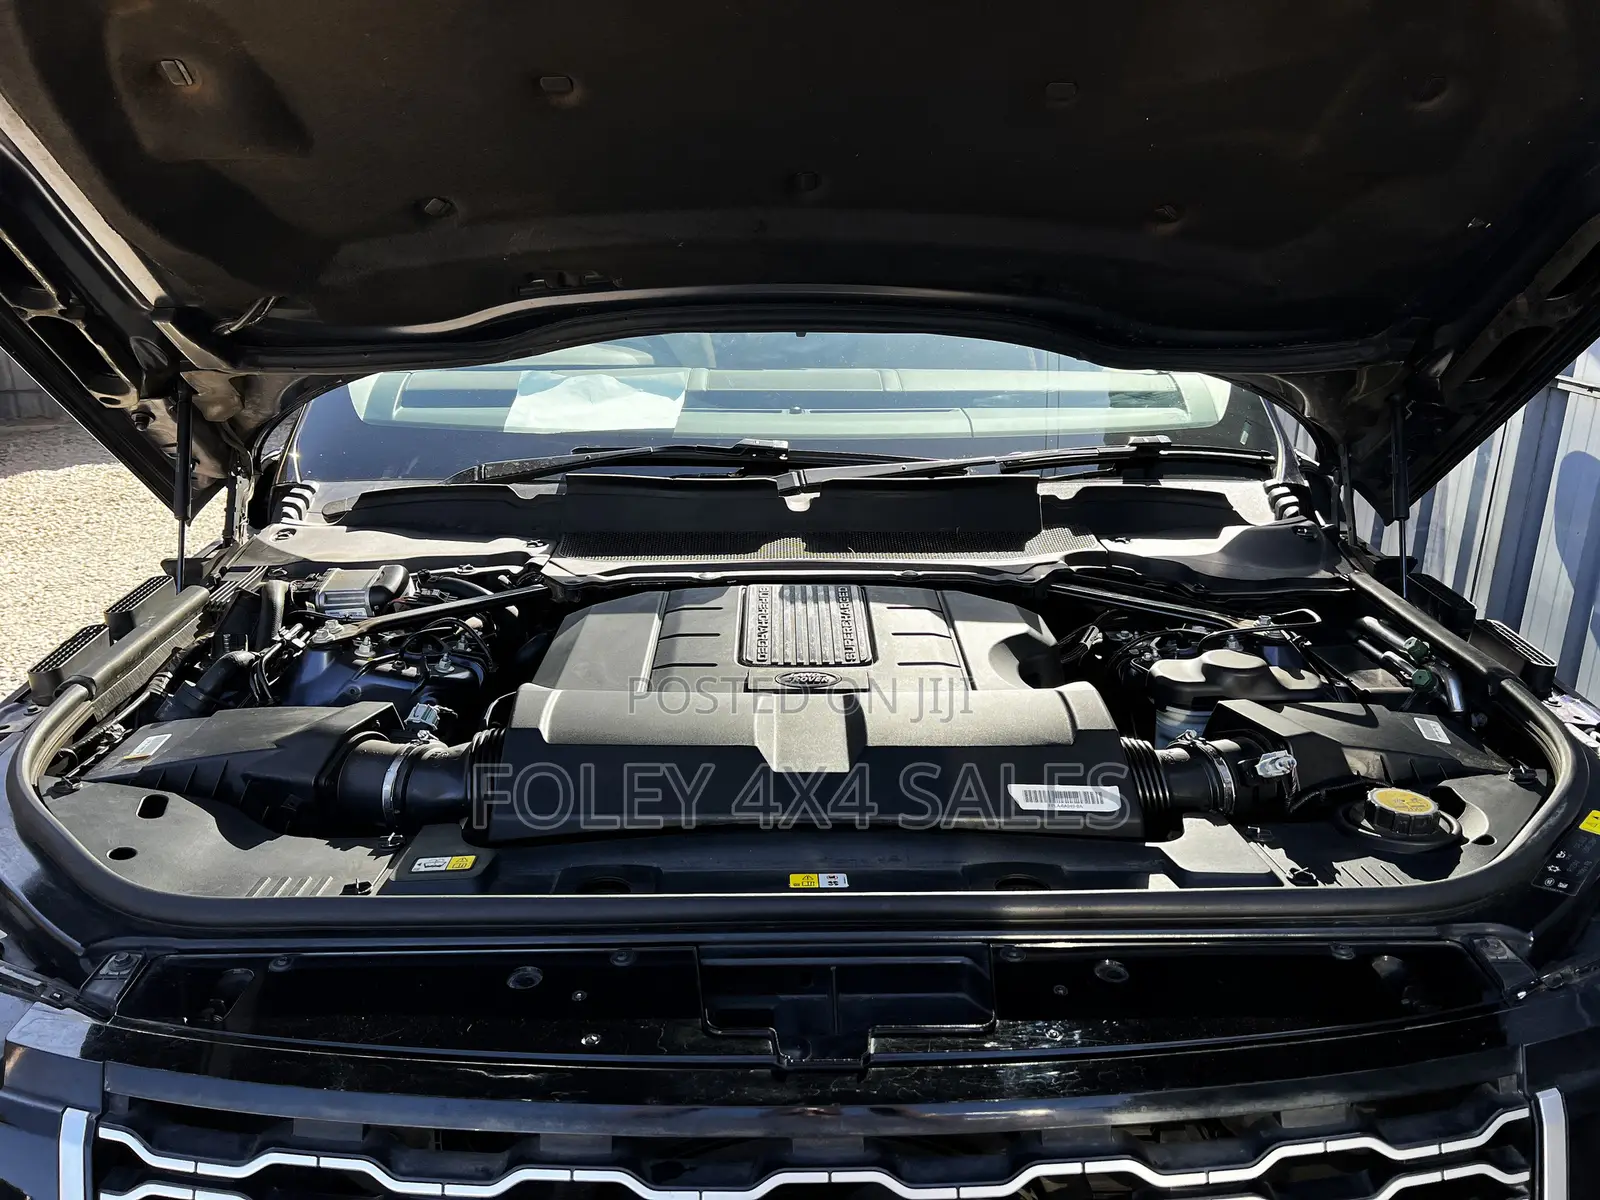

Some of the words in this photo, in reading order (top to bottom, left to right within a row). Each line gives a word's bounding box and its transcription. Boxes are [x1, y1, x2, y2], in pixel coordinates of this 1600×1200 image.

[757, 586, 769, 662] SUPERCHARGED
[839, 586, 857, 662] SUPERCHARGED
[789, 675, 830, 684] ROVER
